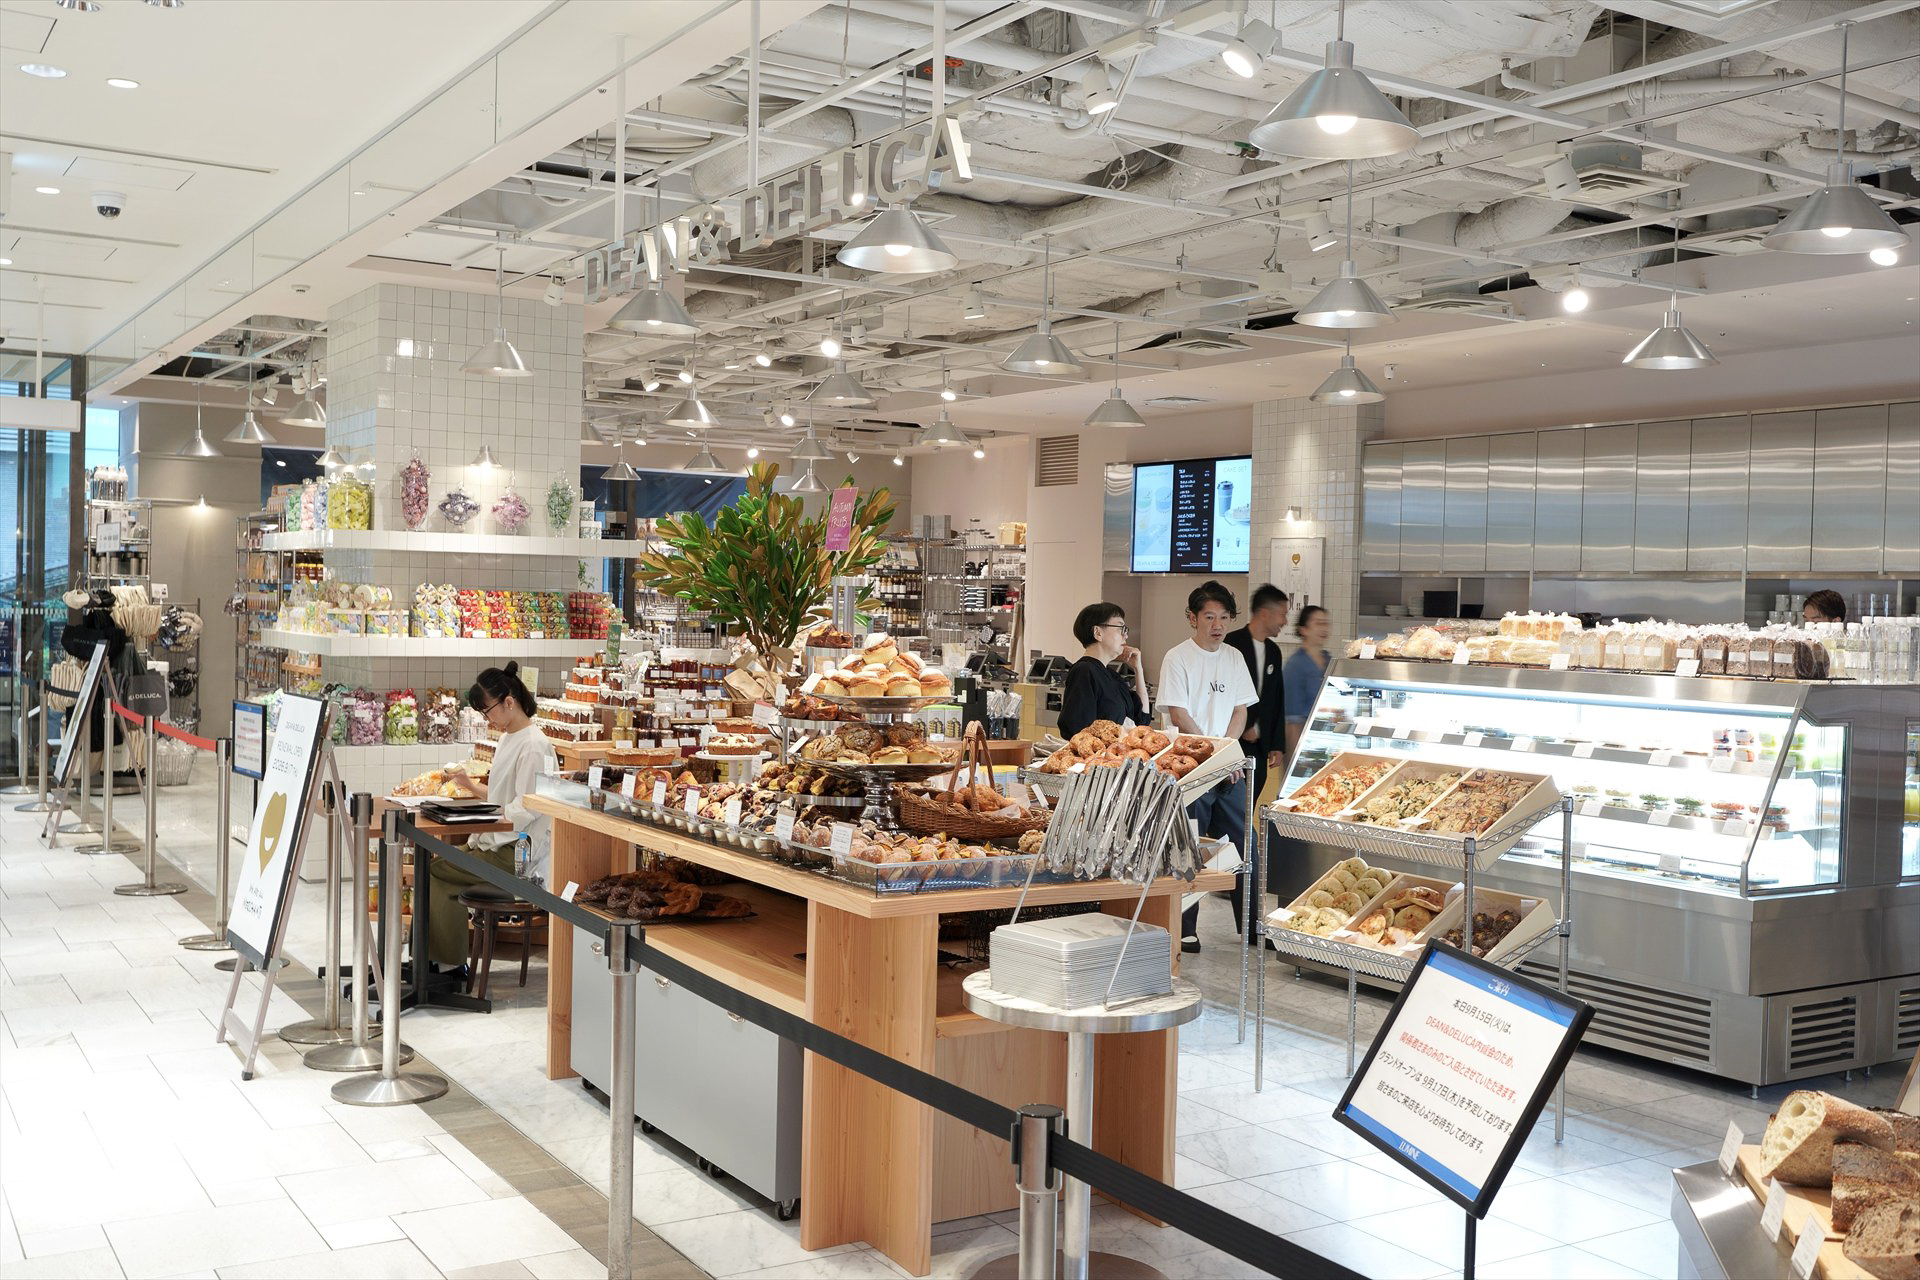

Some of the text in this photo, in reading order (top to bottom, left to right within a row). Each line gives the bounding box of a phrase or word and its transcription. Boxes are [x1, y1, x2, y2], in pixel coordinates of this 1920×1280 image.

[583, 113, 973, 304] DEAN & DELUCA
[1487, 978, 1510, 997] ご案内
